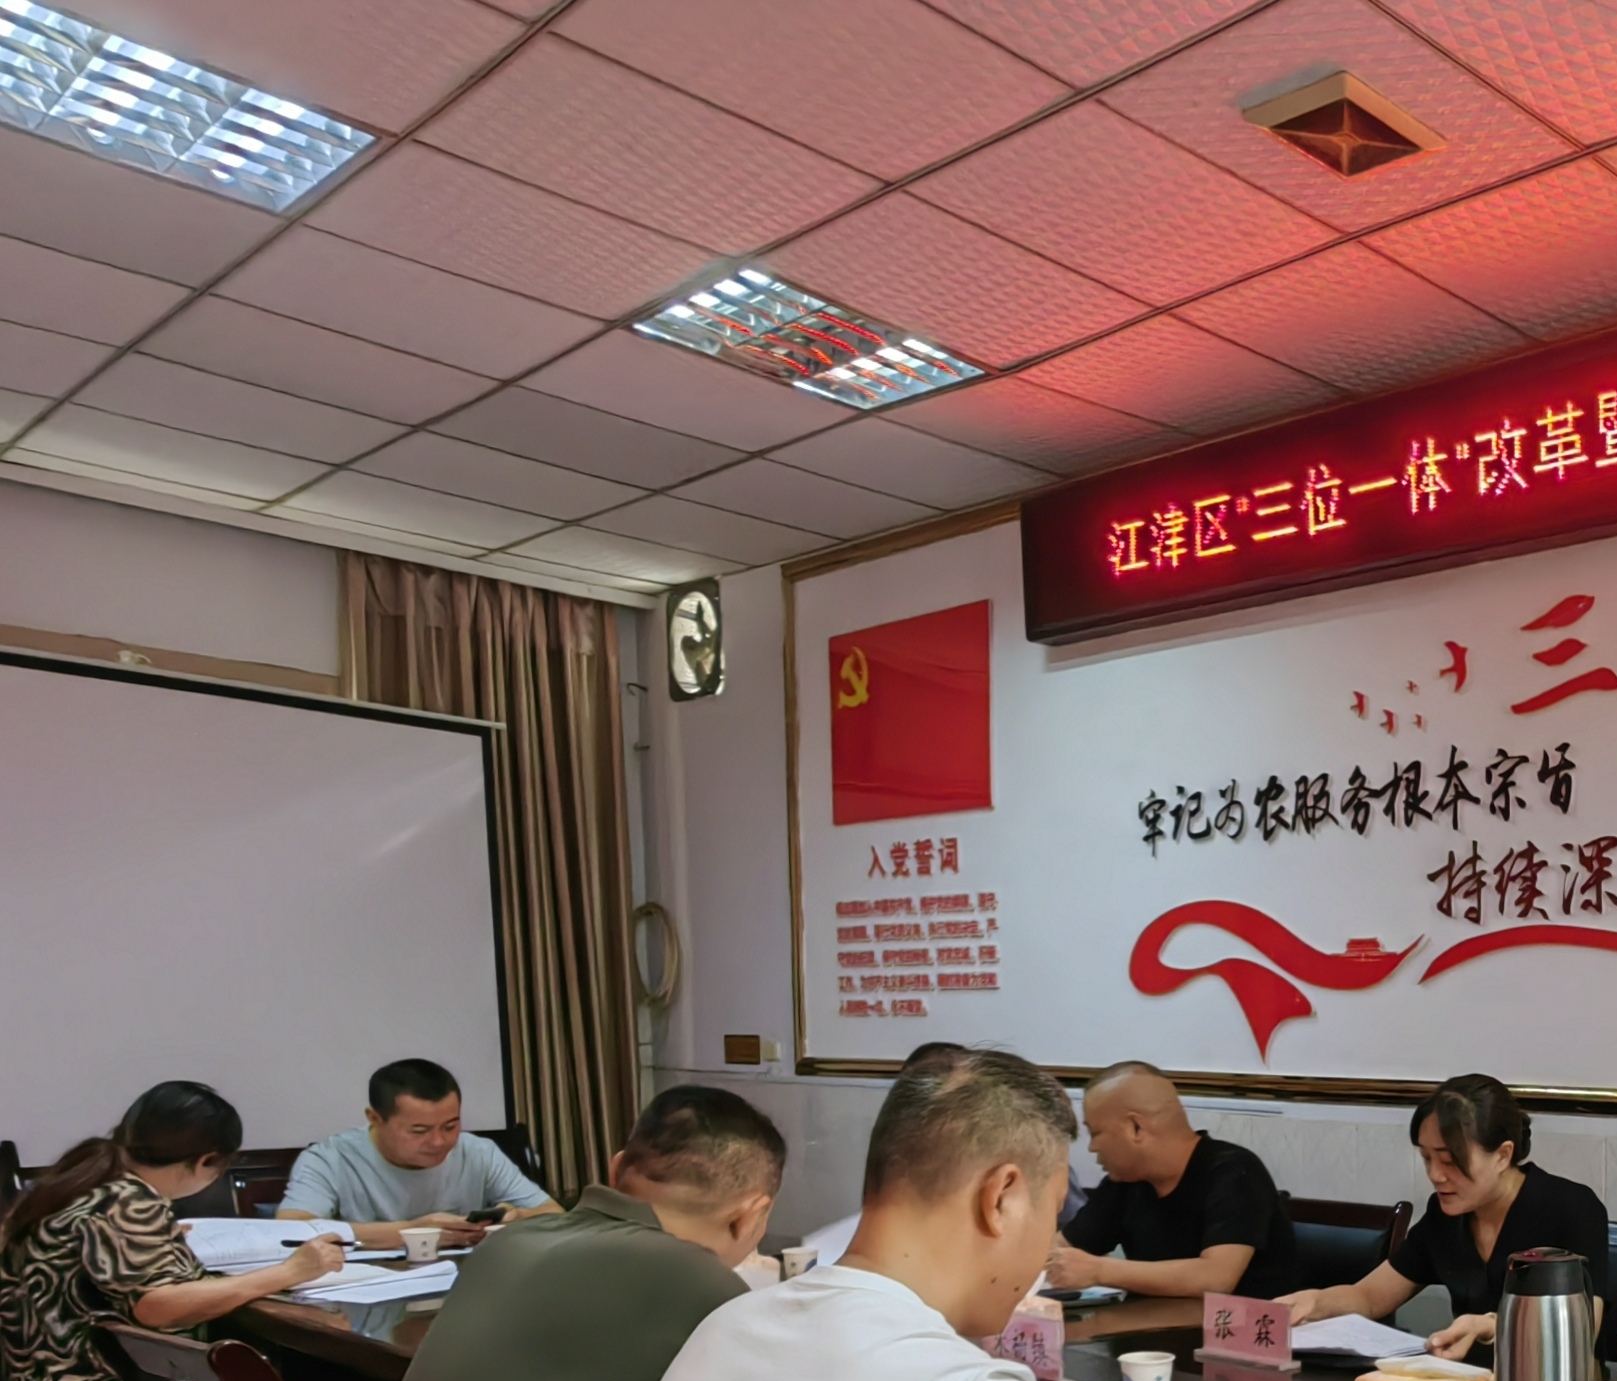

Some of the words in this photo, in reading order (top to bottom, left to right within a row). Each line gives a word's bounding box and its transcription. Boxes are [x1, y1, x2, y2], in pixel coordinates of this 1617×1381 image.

[1137, 742, 1577, 858] 牢记为农服务根本宗旨
[867, 837, 959, 879] 入党誓词
